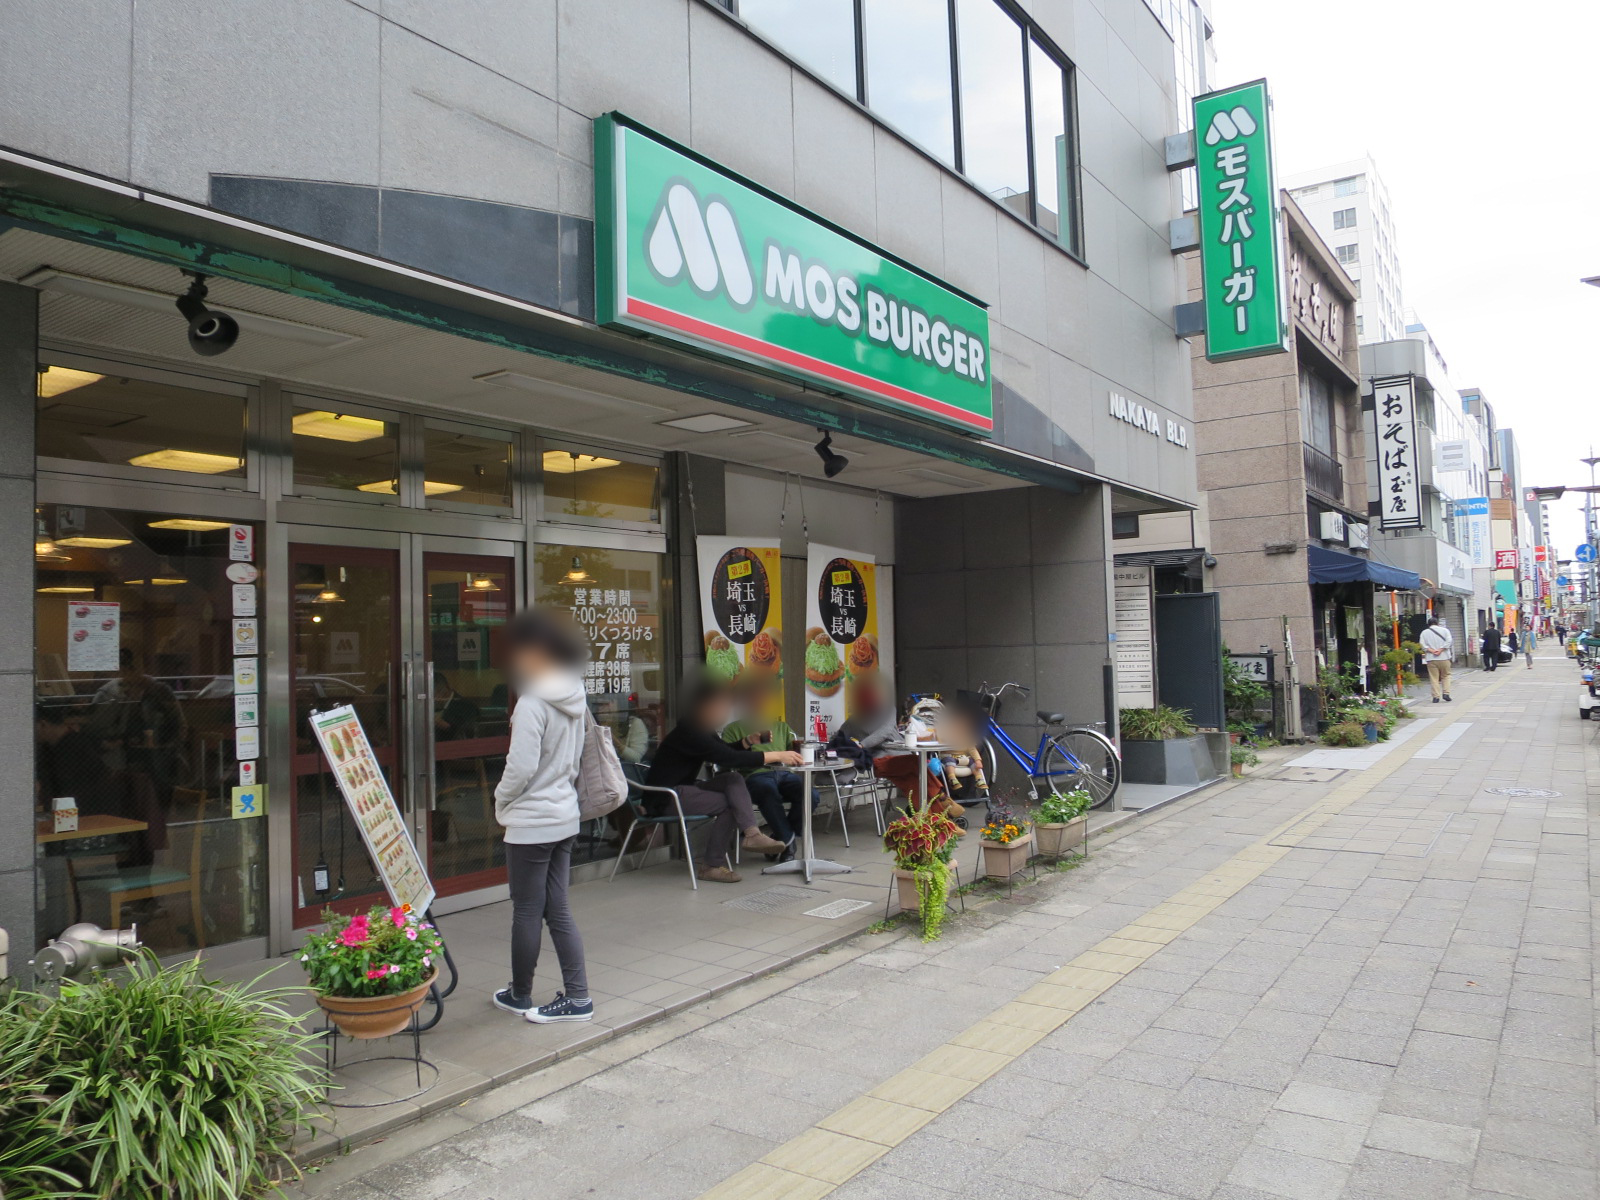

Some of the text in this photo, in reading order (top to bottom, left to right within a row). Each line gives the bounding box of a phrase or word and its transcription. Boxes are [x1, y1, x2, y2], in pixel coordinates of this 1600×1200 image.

[1217, 145, 1256, 332] モスバーガー
[765, 245, 985, 382] MOS BURGER
[1109, 391, 1160, 436] NAKAYA
[1468, 503, 1487, 511] NTN
[1497, 552, 1516, 568] 酒
[574, 588, 631, 606] 営業時間
[726, 581, 756, 603] 埼玉
[830, 586, 856, 608] 埼玉
[728, 612, 757, 636] 長崎
[830, 616, 857, 637] 長崎
